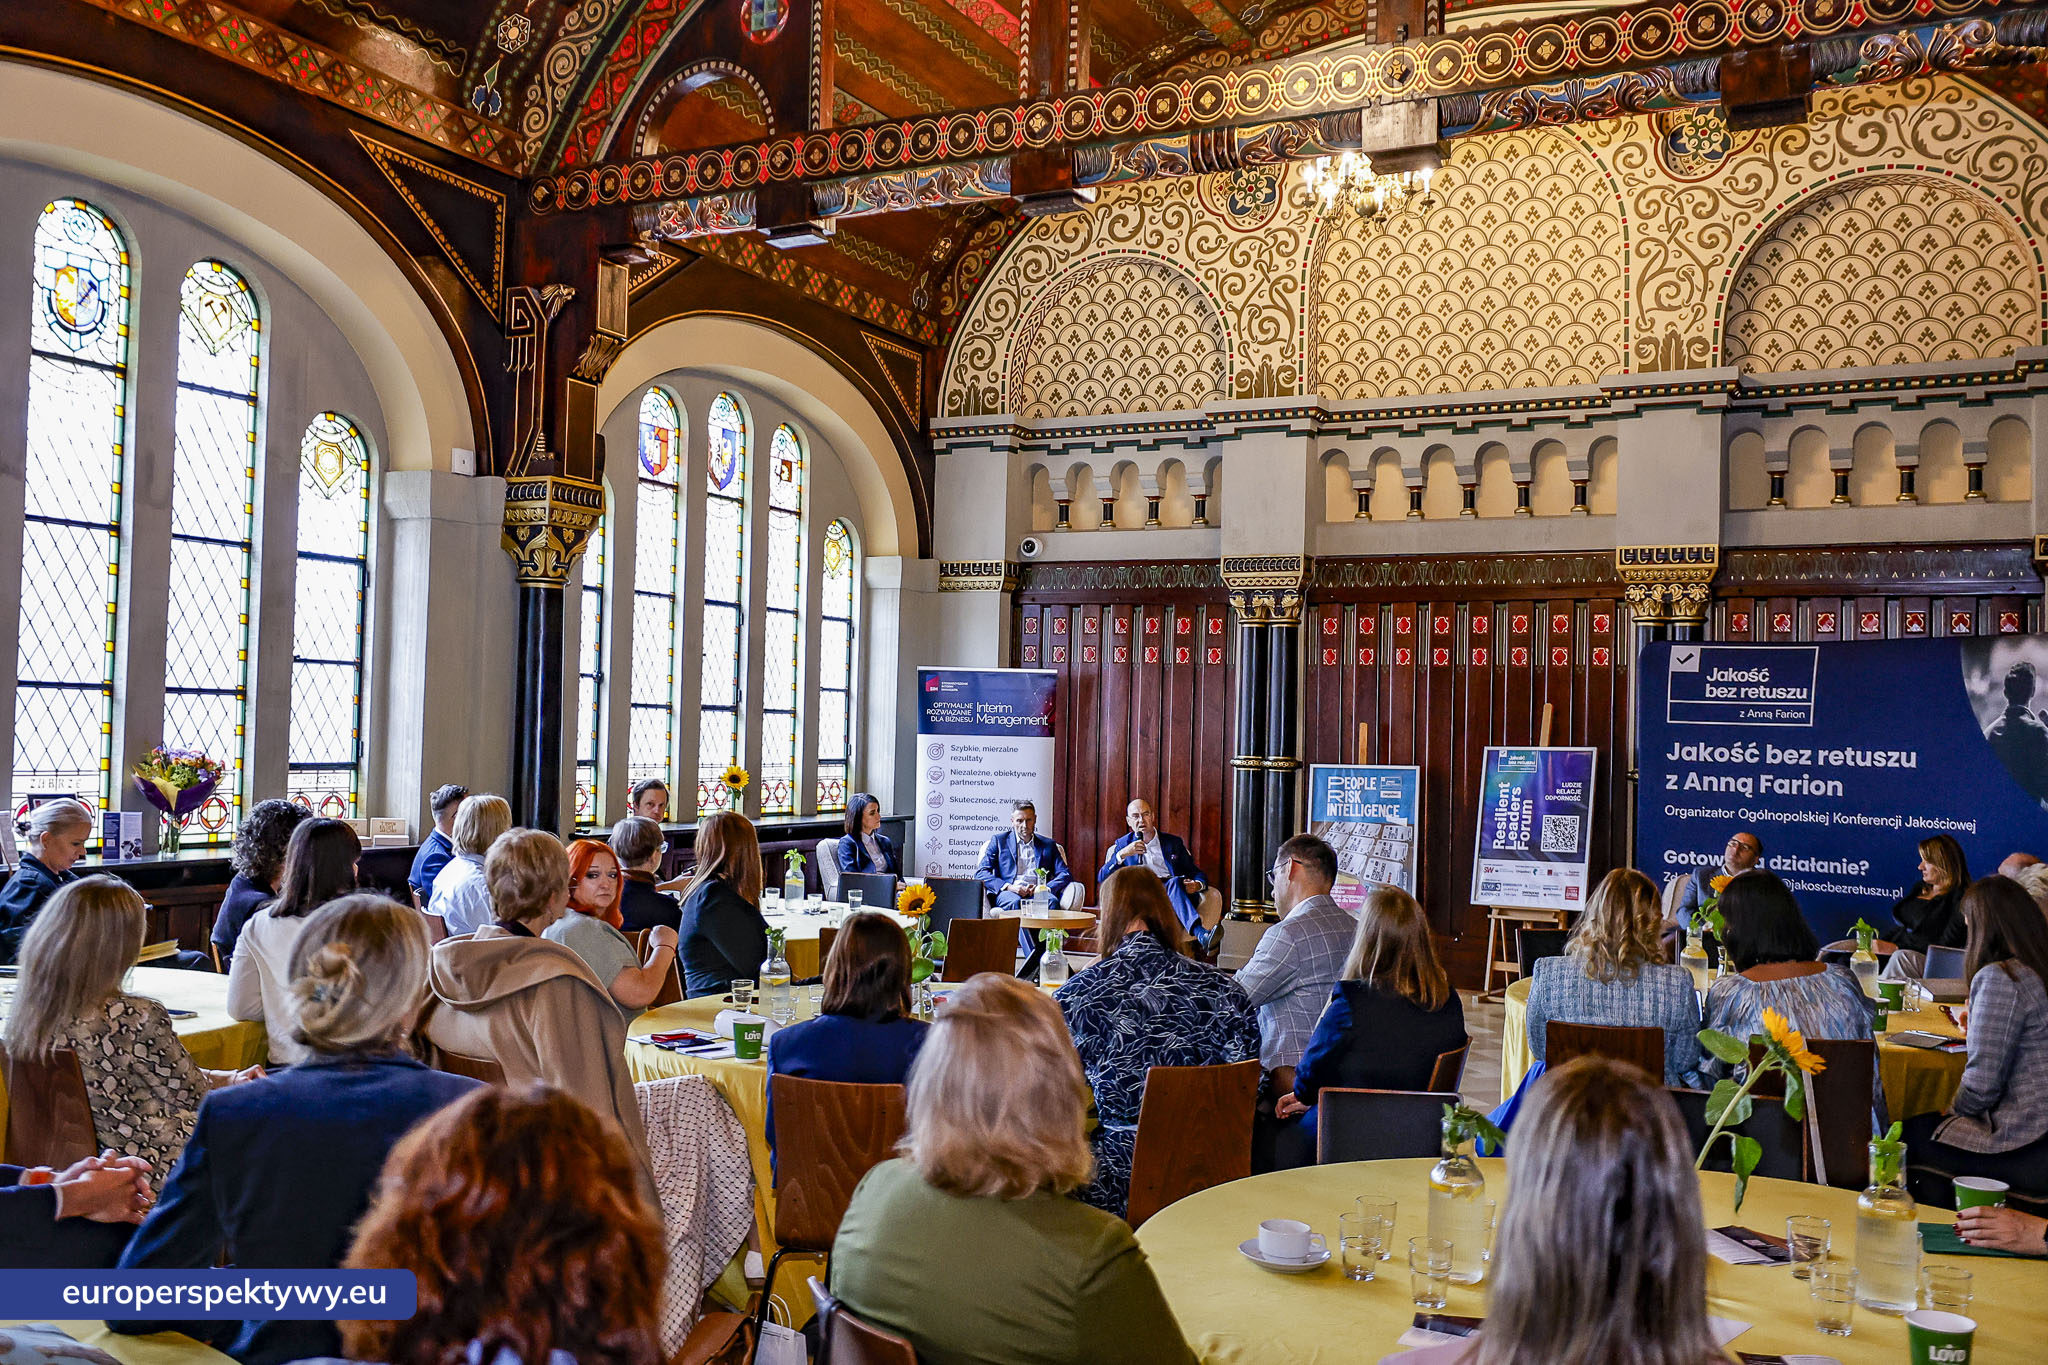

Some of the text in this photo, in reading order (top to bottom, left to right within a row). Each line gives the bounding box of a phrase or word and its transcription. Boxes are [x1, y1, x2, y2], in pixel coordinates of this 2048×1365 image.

[1706, 667, 1770, 683] Jakość
[1705, 683, 1808, 699] bez retuszu
[976, 702, 1013, 713] Interim
[1739, 709, 1806, 720] z Anną Farion
[976, 713, 1048, 728] Management
[950, 744, 1019, 753] Szybkie, mierzalne
[1666, 742, 1917, 768] Jakość bez retuszu
[950, 755, 983, 763] rezultaty
[950, 768, 1037, 778] Niezależne, obiektywne
[949, 779, 995, 787] partnerstwo
[1327, 776, 1377, 790] PEOPLE
[1665, 772, 1843, 797] z Anną Farion
[1327, 789, 1361, 803] RISK
[1326, 803, 1400, 818] INTELLIGENCE
[1493, 782, 1511, 850] Resilient
[1505, 786, 1522, 850] Leaders
[1517, 799, 1534, 851] Forum
[1664, 804, 1977, 835] Organizator Ogólnopolskiej Konferencji Jakościowej
[948, 838, 986, 847] Elastyczn
[1663, 849, 1725, 867] Gotow
[1769, 854, 1870, 876] działanie?
[1928, 1345, 1967, 1362] LOYD
